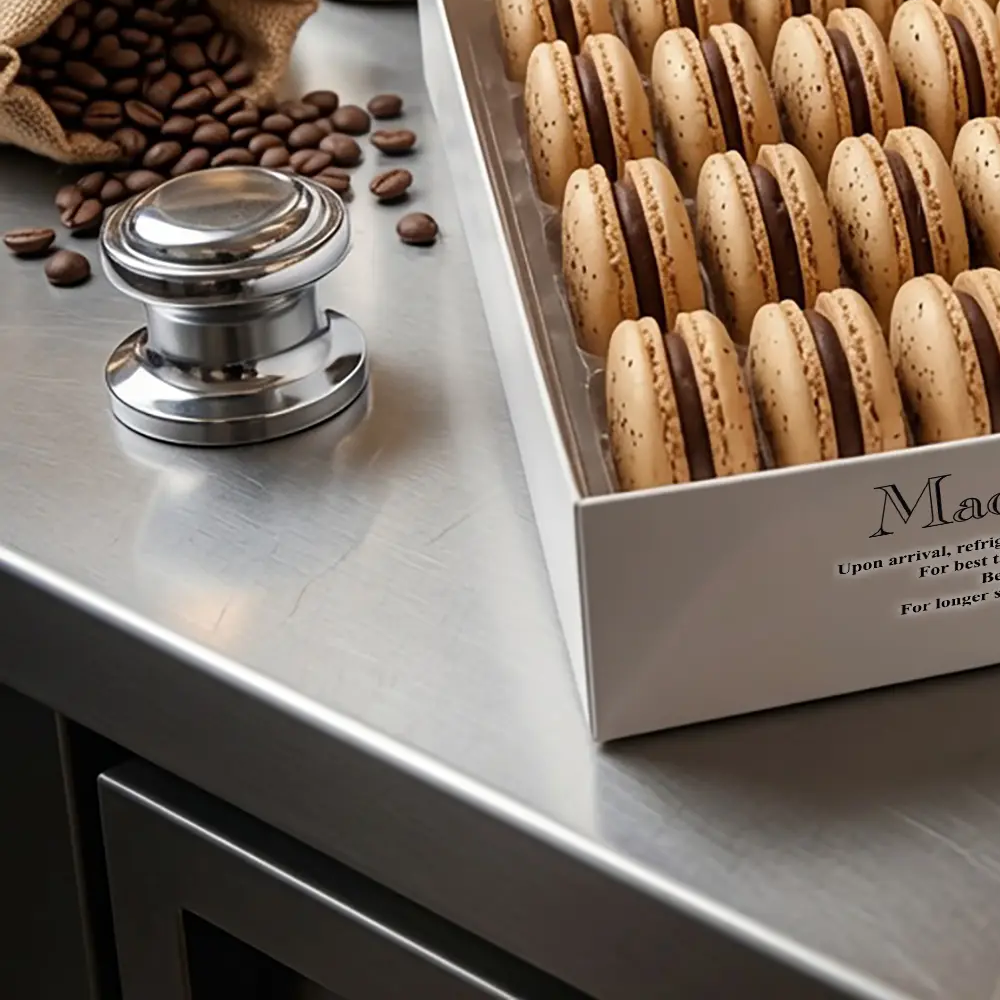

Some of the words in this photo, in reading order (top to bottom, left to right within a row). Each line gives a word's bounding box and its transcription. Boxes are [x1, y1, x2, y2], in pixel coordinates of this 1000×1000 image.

[837, 559, 883, 576] Upon
[889, 546, 951, 567] arrival,
[919, 564, 949, 578] For
[954, 556, 987, 572] best
[900, 600, 931, 616] For
[935, 590, 989, 610] longer
